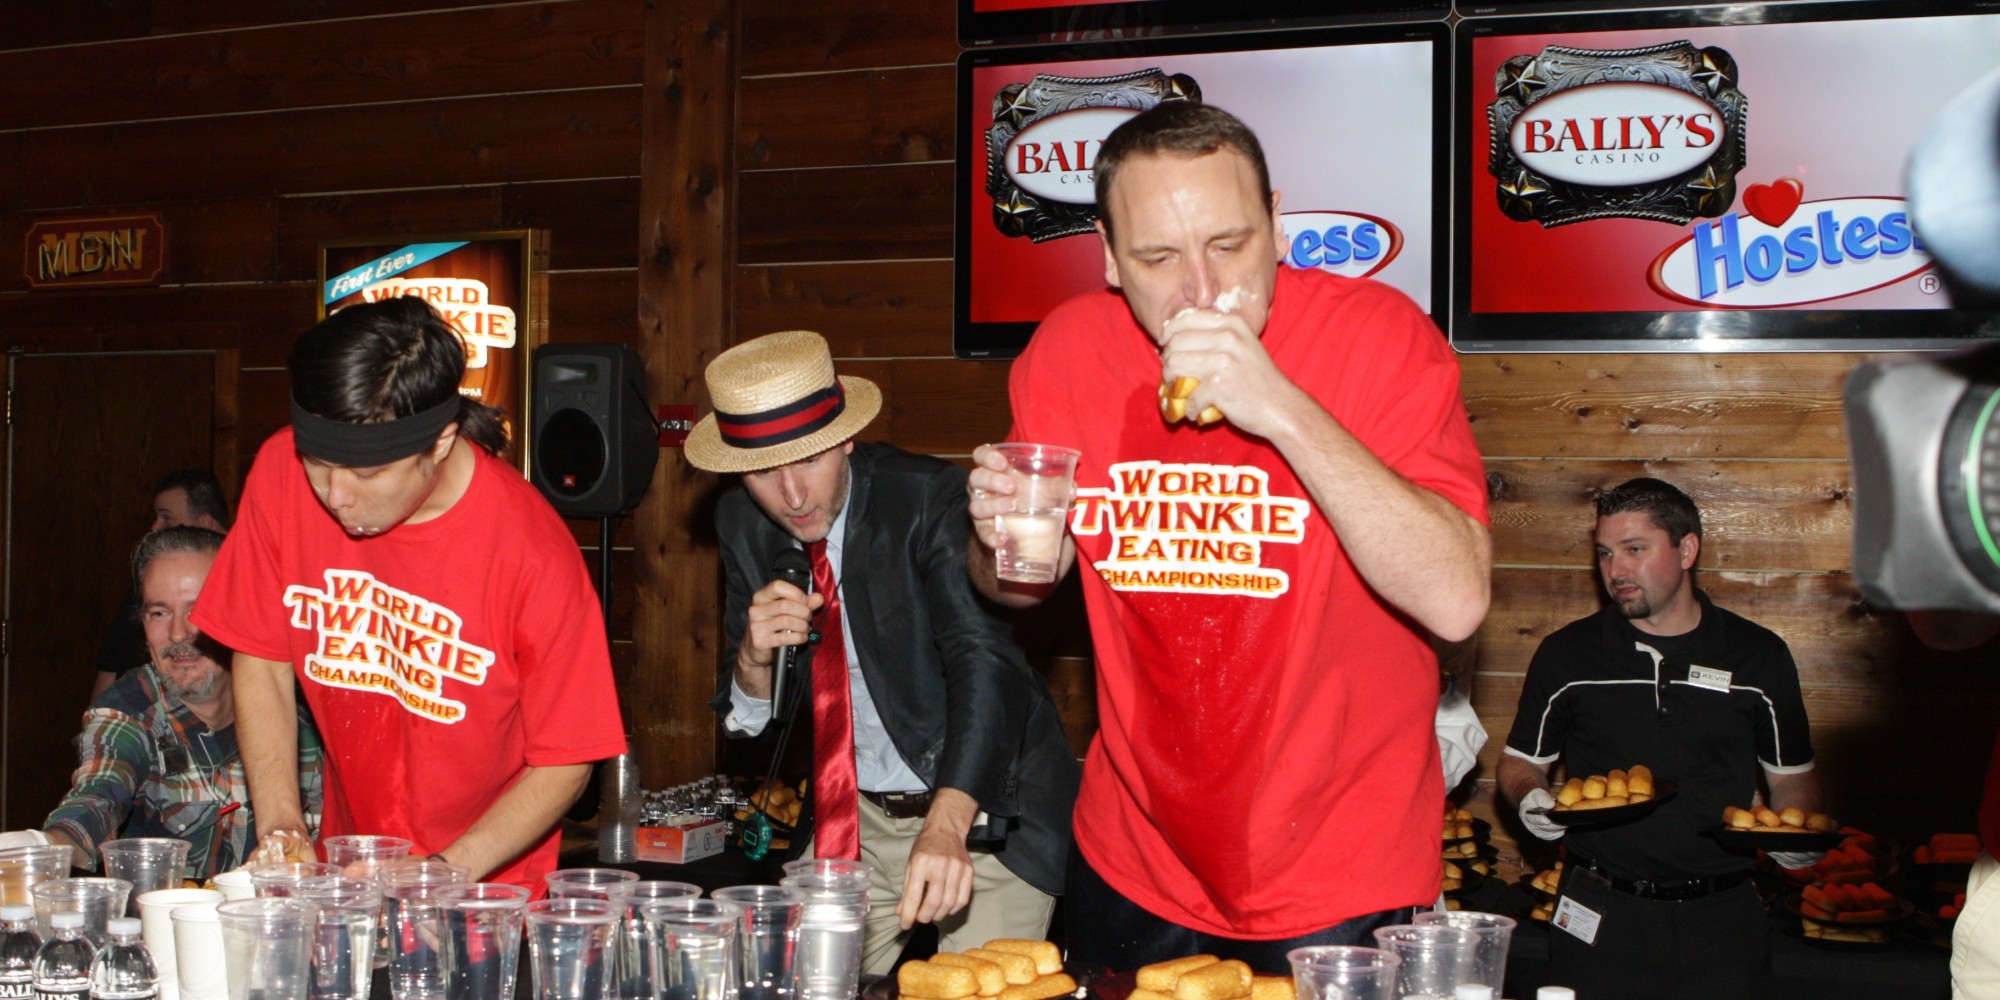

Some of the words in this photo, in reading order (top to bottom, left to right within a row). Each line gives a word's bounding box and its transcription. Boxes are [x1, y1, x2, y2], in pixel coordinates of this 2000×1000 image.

[1522, 113, 1715, 153] BALLY'S
[1575, 153, 1660, 164] CASINO
[331, 269, 373, 298] First
[375, 252, 415, 277] Ever
[1118, 468, 1263, 498] WORLD
[1075, 496, 1298, 537] TWINKIE
[1116, 536, 1254, 564] EATING
[1100, 569, 1283, 592] CHAMPIONSHIP
[331, 576, 455, 638] WORLD
[292, 592, 484, 680] TWINKIE
[322, 636, 437, 692] EATING
[1703, 673, 1729, 682] KEVIN
[309, 660, 460, 719] CHAMPIONSHIP
